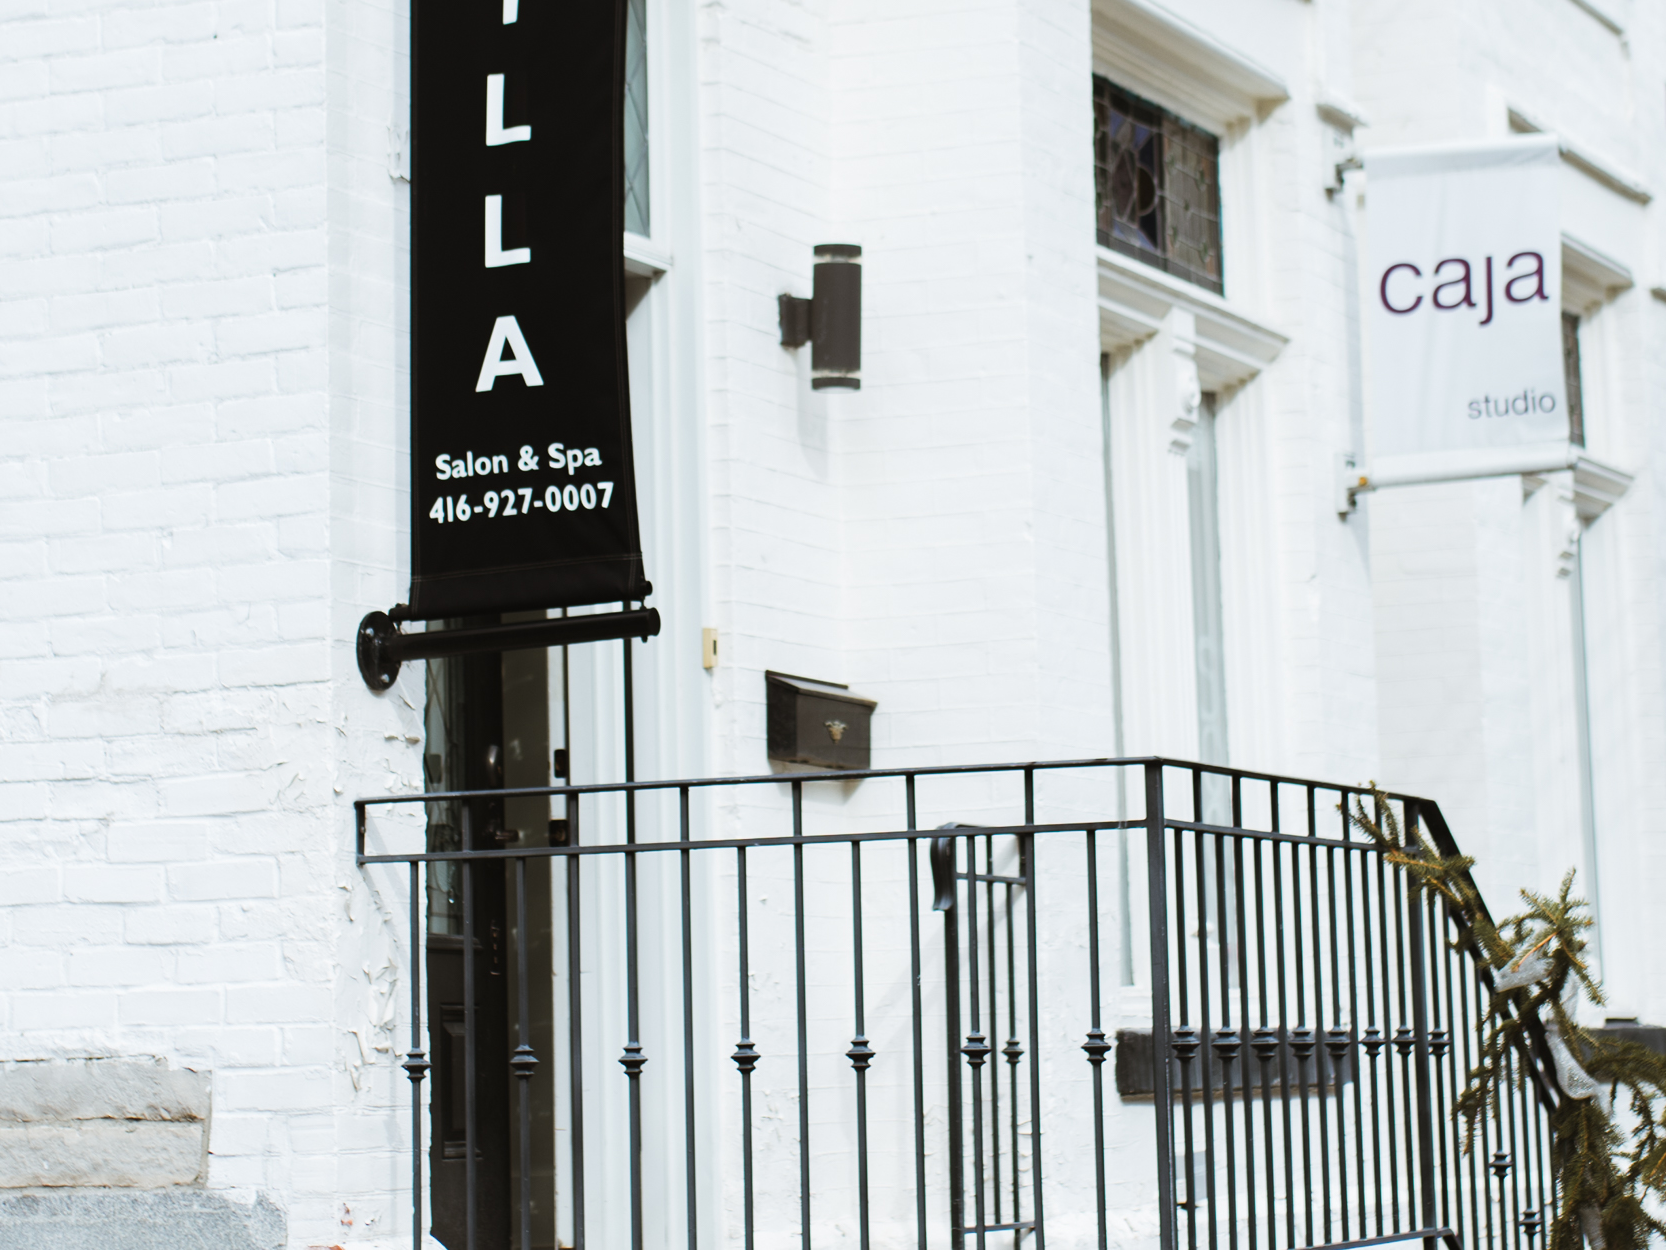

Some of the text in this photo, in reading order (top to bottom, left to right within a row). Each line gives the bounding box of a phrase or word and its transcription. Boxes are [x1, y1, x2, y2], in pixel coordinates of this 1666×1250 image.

[1379, 250, 1550, 327] caja
[1467, 389, 1557, 420] studio
[435, 442, 603, 481] Salon & Spa
[428, 481, 614, 524] 416-927-0007
